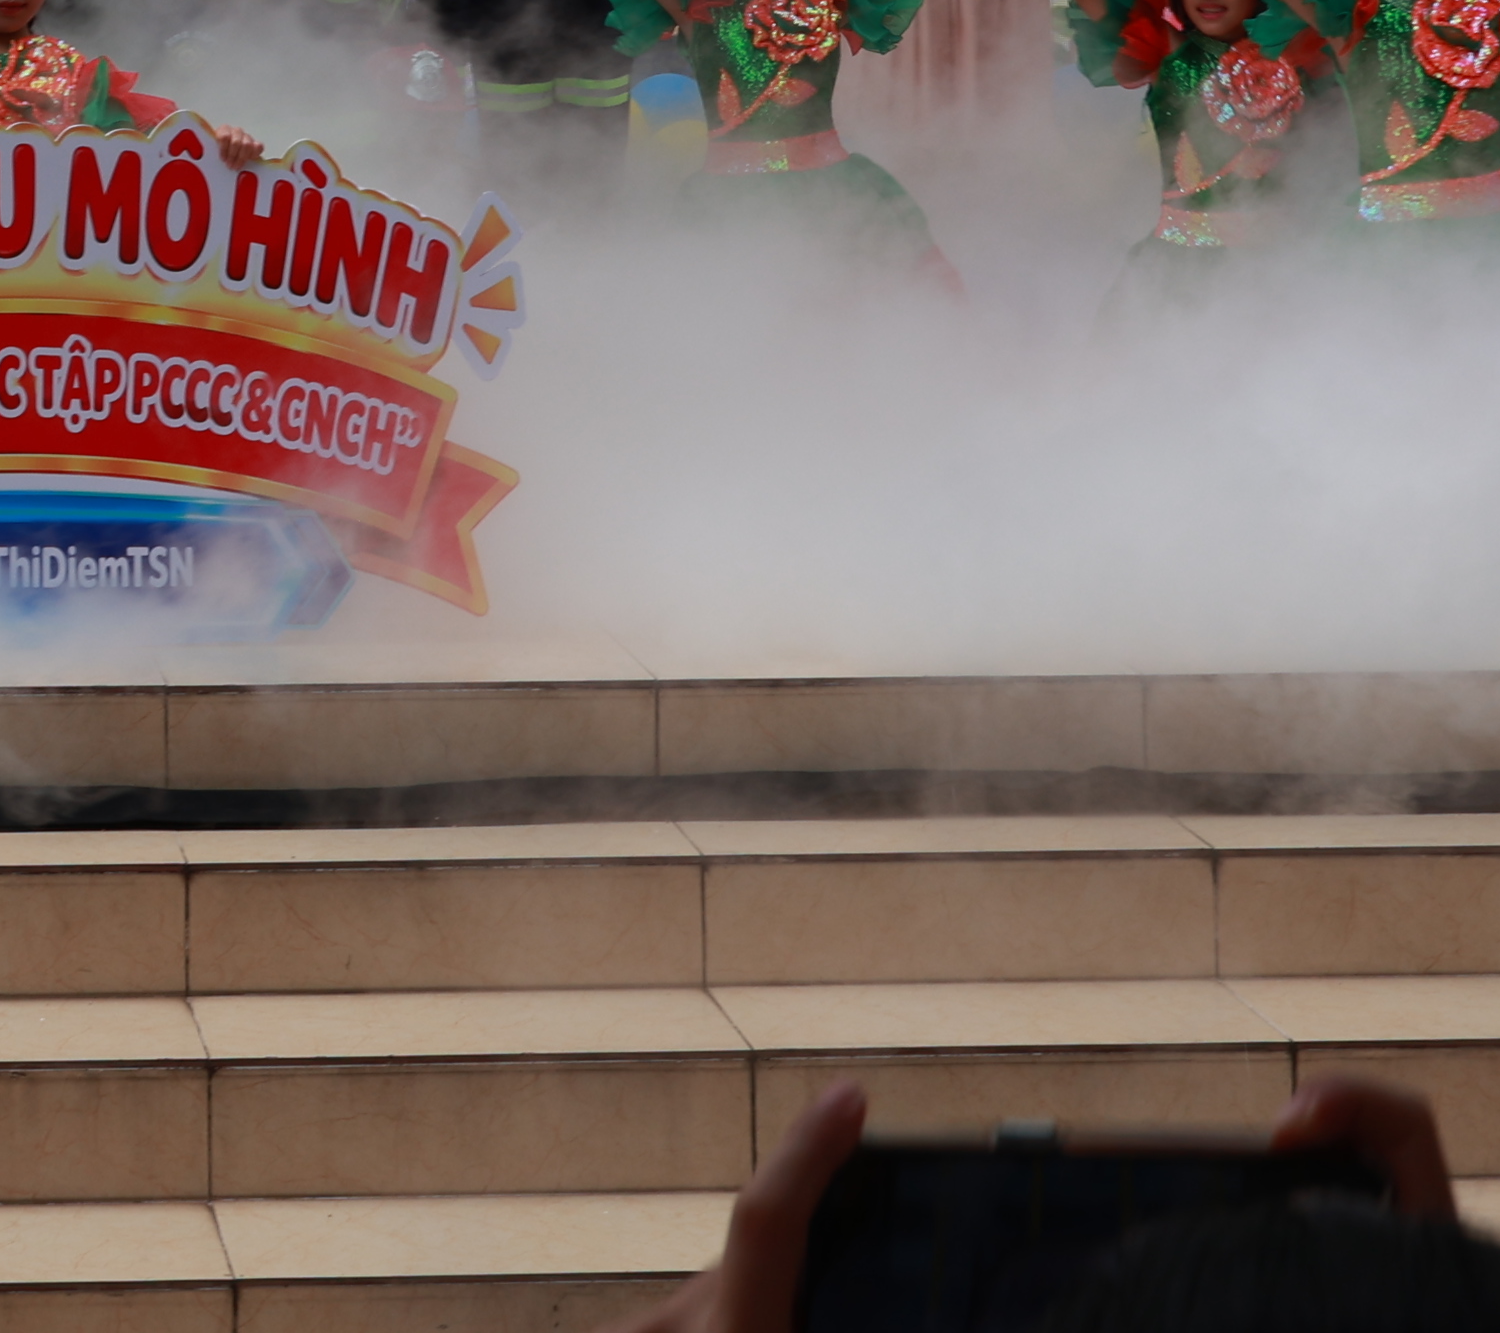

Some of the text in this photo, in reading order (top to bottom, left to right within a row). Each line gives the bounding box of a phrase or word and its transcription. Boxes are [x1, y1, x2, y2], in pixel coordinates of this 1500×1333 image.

[63, 128, 211, 273] MÔ
[225, 158, 450, 345] HÌNH
[33, 334, 127, 432] TẬP
